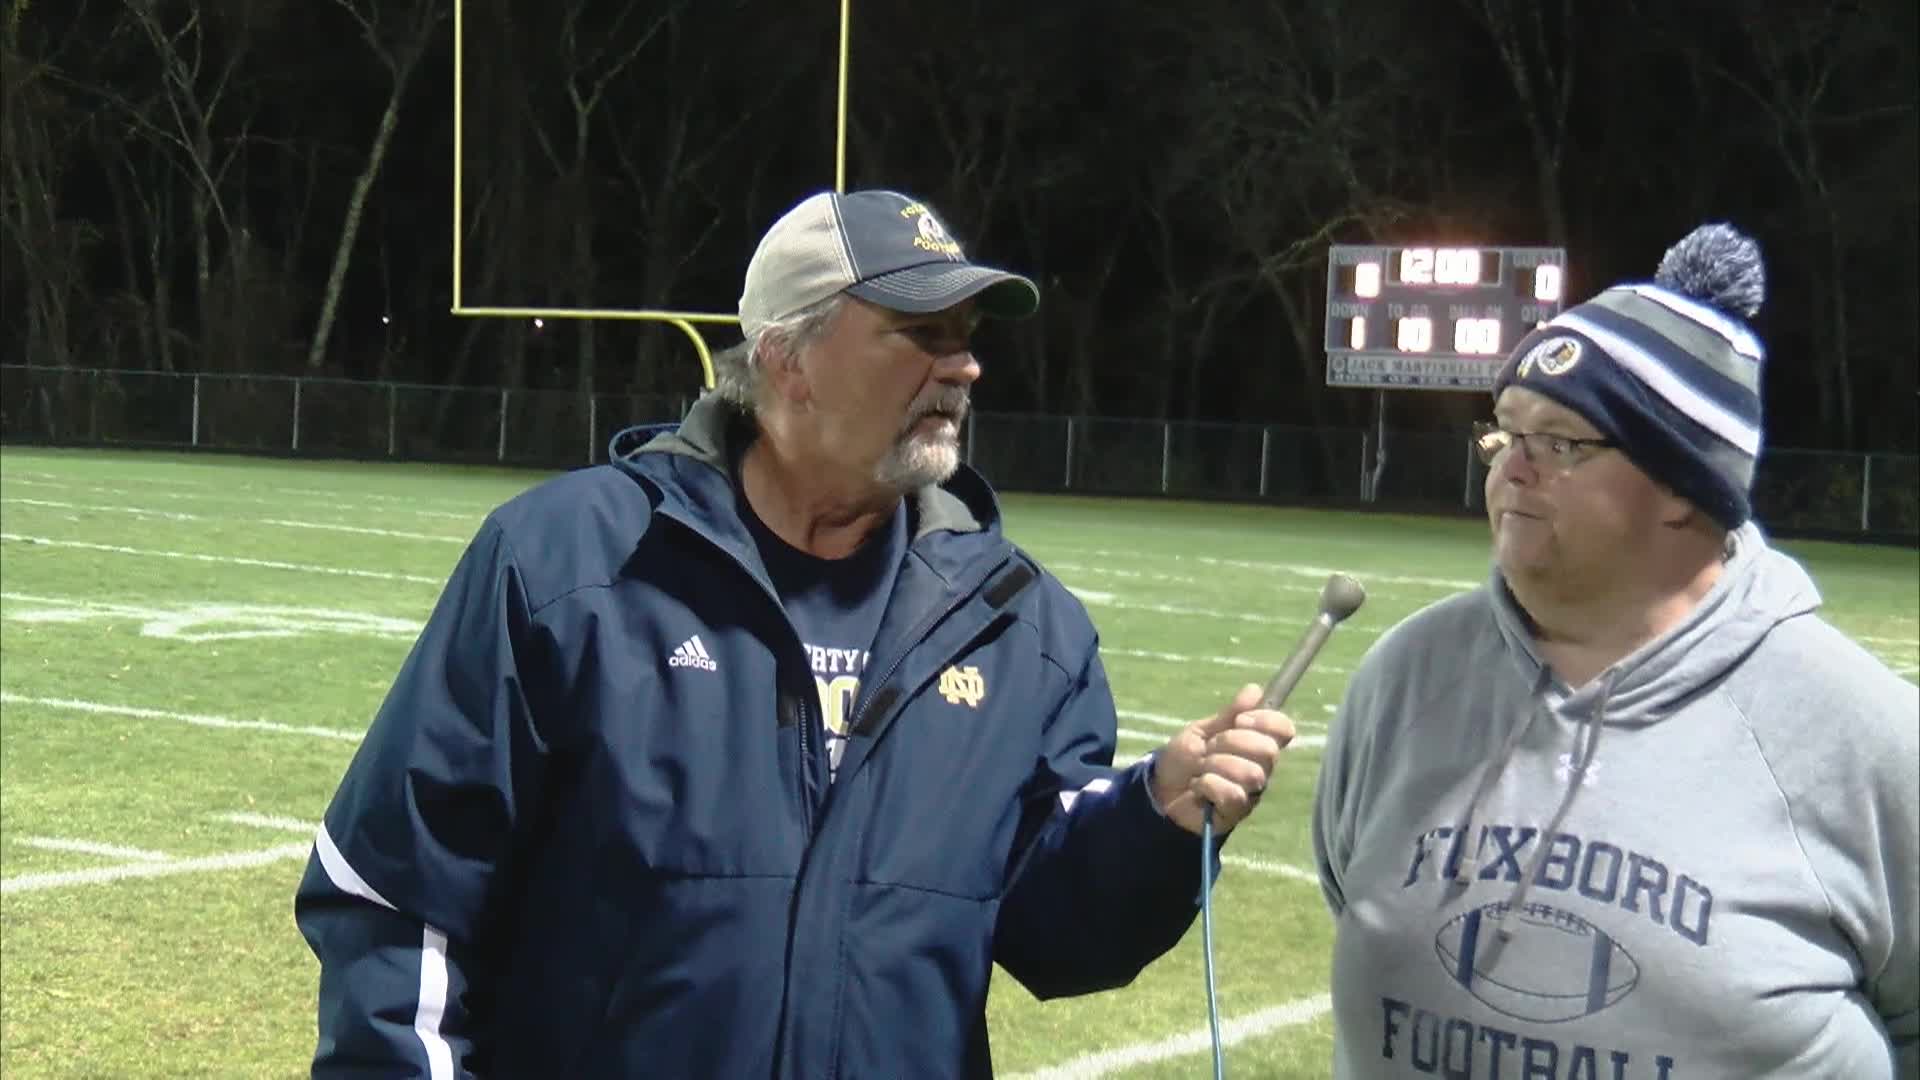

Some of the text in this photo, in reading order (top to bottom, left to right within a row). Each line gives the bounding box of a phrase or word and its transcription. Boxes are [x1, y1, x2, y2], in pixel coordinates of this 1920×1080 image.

[1535, 264, 1560, 300] 0
[1331, 304, 1369, 318] DOWN
[1388, 304, 1403, 319] TO
[1351, 316, 1365, 350] 1
[1398, 317, 1432, 352] 10
[669, 656, 717, 671] adidas
